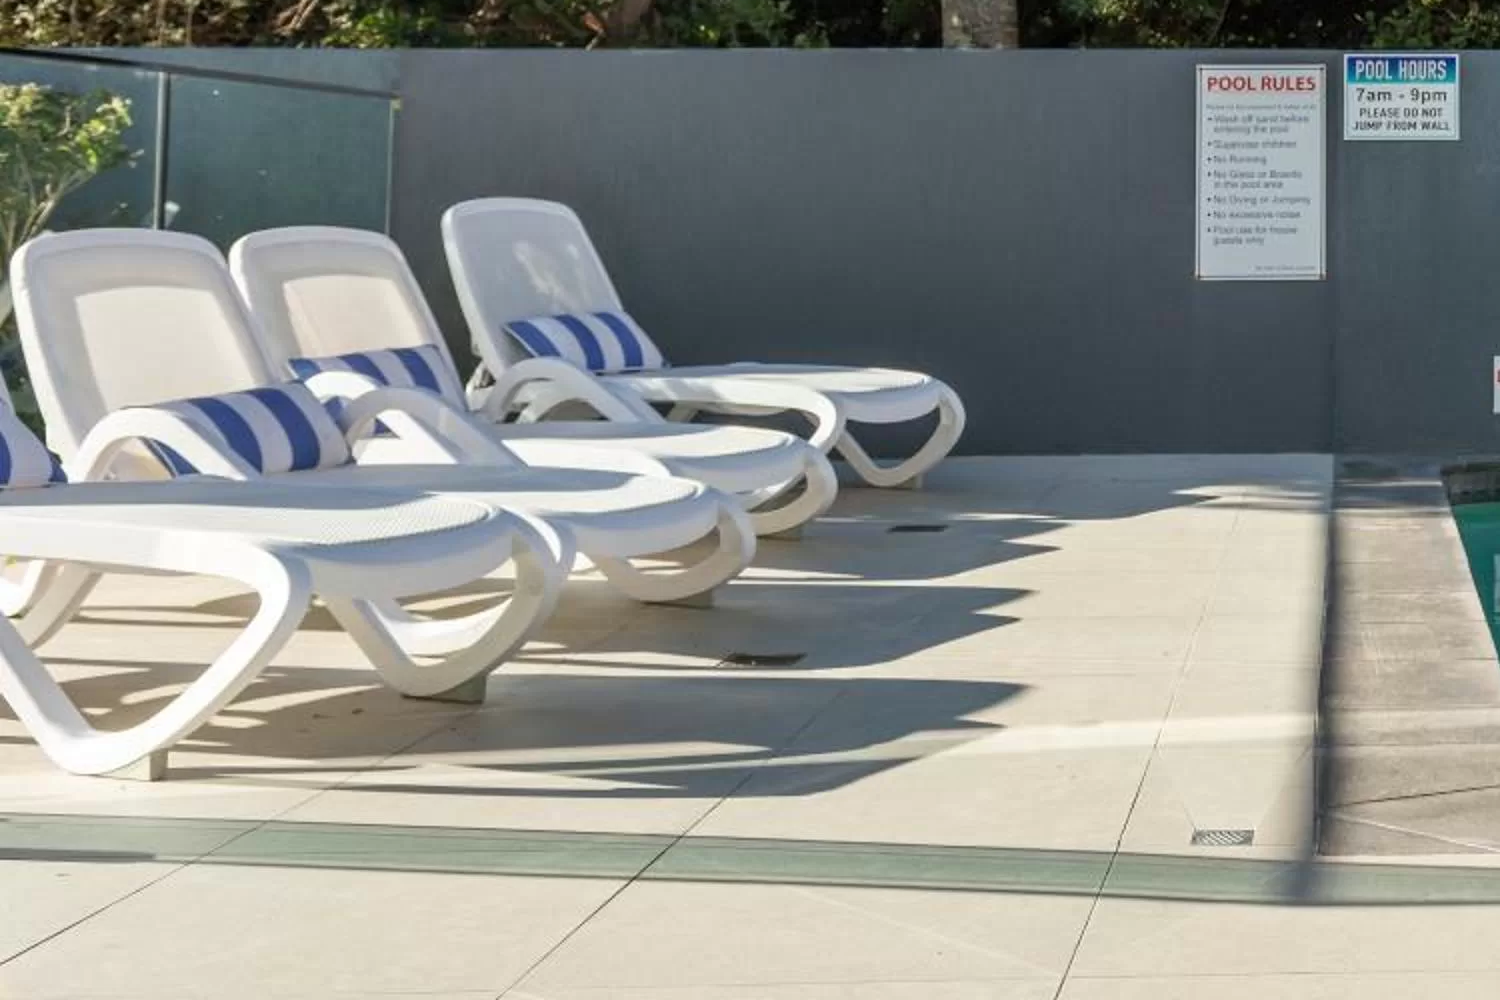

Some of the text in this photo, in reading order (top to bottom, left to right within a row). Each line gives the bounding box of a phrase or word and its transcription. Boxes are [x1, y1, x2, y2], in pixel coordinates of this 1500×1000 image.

[1355, 59, 1447, 80] POOL HOURS
[1207, 76, 1316, 92] POOL RULES
[1356, 88, 1392, 102] 7am
[1410, 87, 1448, 104] 9pm
[1360, 107, 1444, 118] PLEASE DO NOT
[1354, 121, 1450, 131] JUMP FROM WALL
